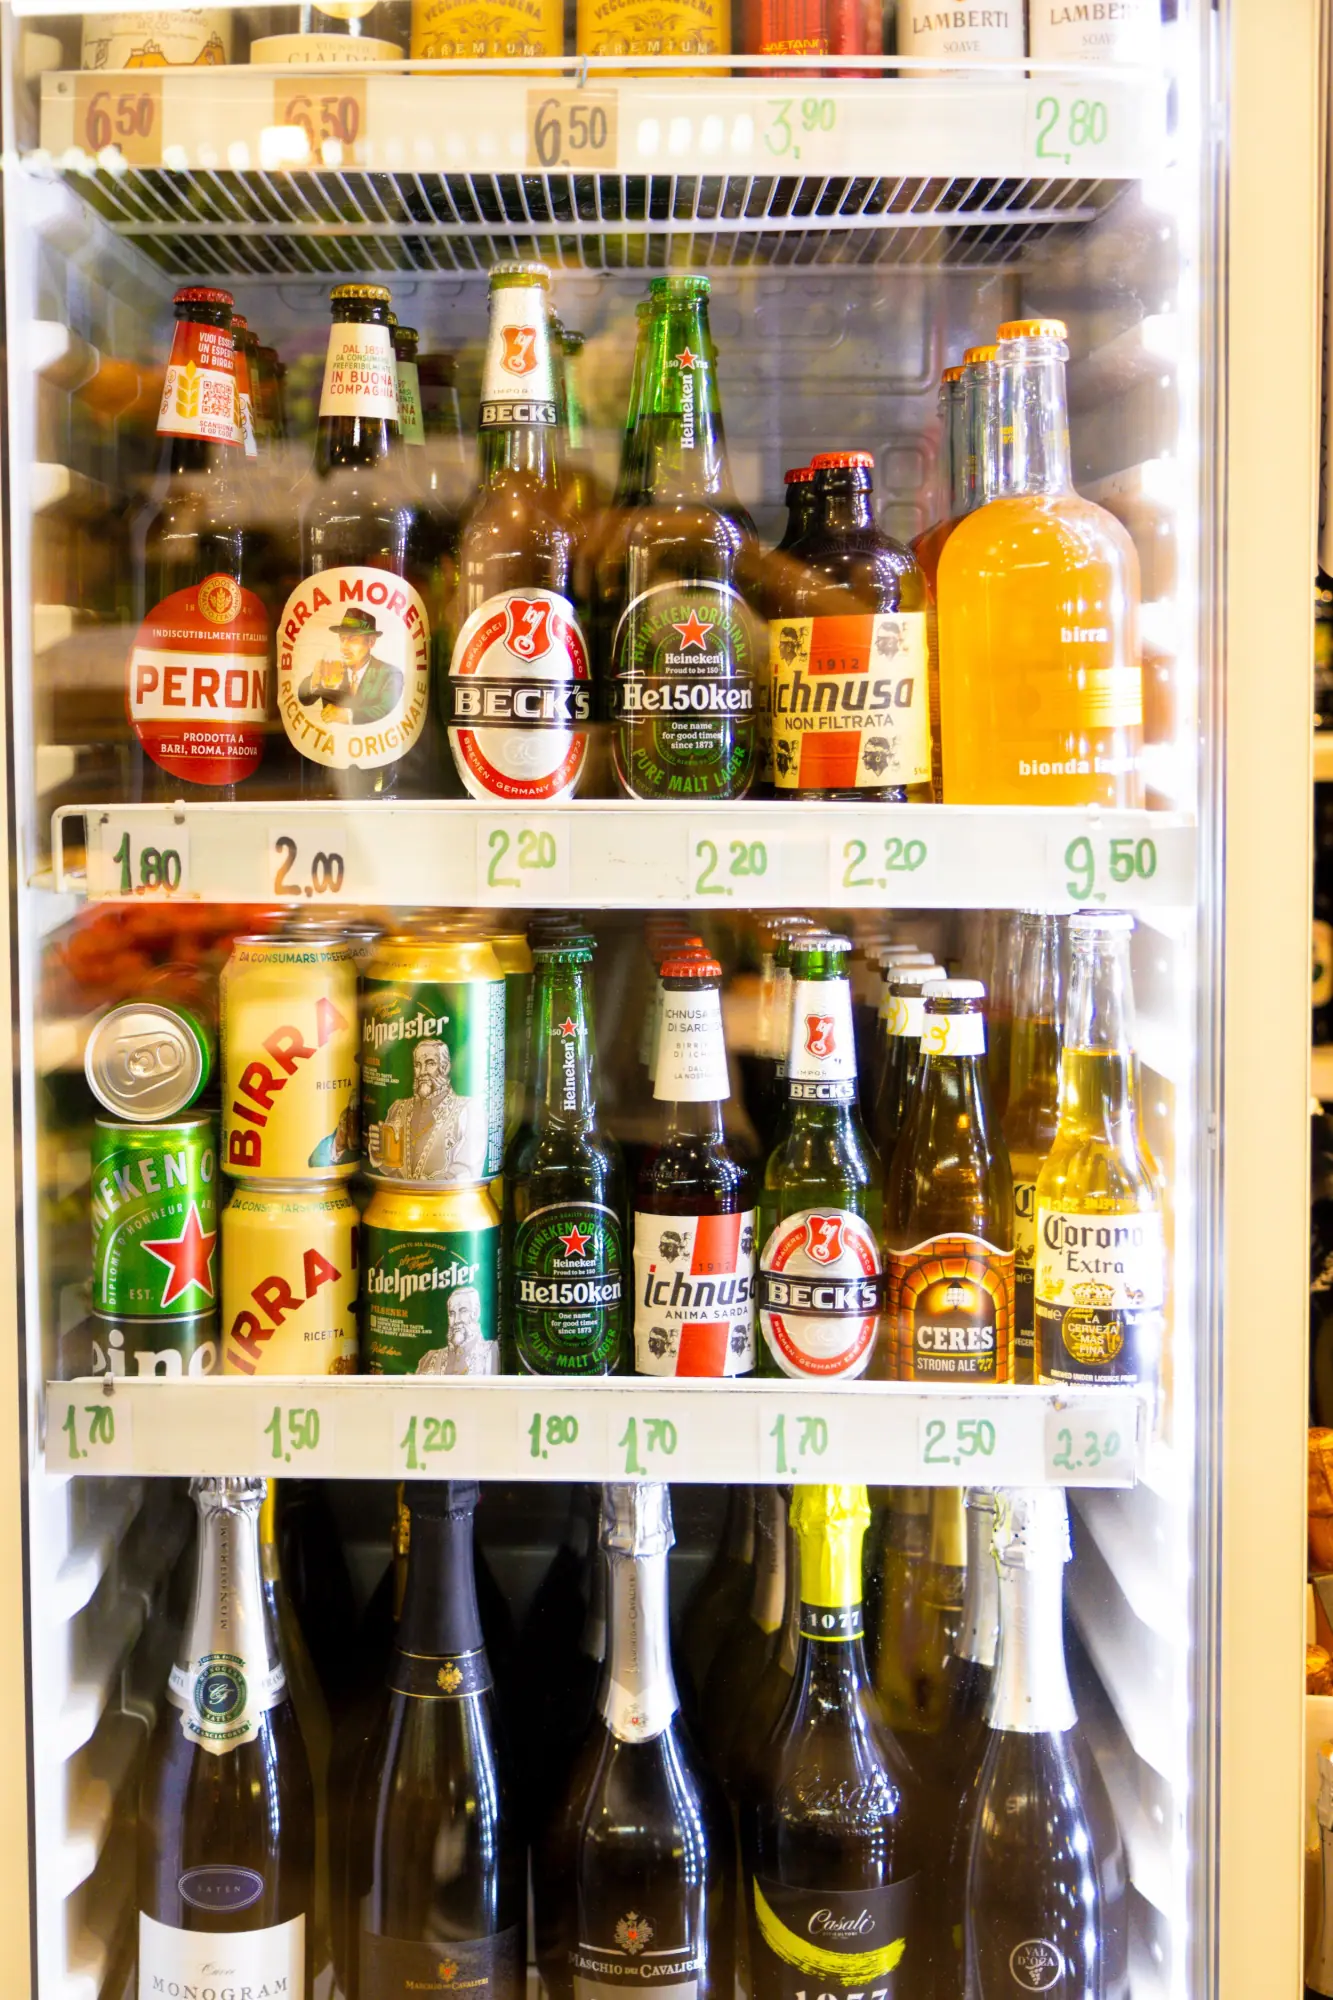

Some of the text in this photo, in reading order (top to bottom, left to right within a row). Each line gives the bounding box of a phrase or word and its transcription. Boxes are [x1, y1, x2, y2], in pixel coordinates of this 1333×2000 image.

[912, 11, 1009, 34] LAMBERTI
[427, 41, 536, 57] PREMIUM
[599, 41, 710, 57] PREMIUM
[943, 40, 981, 53] SOAVE
[199, 332, 216, 344] VUOI
[198, 343, 209, 353] UN
[342, 344, 360, 354] DAL
[200, 354, 209, 364] DI
[335, 353, 344, 362] DA
[331, 370, 393, 388] IN BUONA
[482, 402, 557, 424] BECK'S
[680, 373, 695, 449] Heineken
[280, 579, 428, 671] BIRRA MORETTI
[152, 628, 240, 641] INDISCUTIBILMENTE
[630, 605, 748, 663] HEINEKEN ORIGINAL
[1060, 627, 1109, 643] birra
[465, 622, 504, 670] BRAUEREI
[664, 652, 720, 665] Heineken
[816, 658, 860, 670] 1912
[664, 666, 688, 675] Proud
[688, 666, 696, 674] to
[696, 666, 707, 674] be
[454, 684, 590, 721] BECK'S
[622, 683, 753, 711] He150ken
[280, 679, 428, 759] RICETTA ORIGINALE
[671, 721, 713, 730] One name
[784, 713, 894, 730] NON FILTRATA
[183, 732, 245, 744] PRODOTTA A
[661, 731, 722, 742] for good times
[160, 743, 259, 757] BARI, ROMA, PADOVA
[670, 739, 714, 750] since 1873
[462, 736, 491, 782] BREMEN
[495, 779, 551, 796] GERMANY
[631, 747, 665, 785] PURE
[668, 774, 709, 794] MALT
[713, 745, 746, 788] LAGER
[1018, 757, 1091, 777] bionda
[239, 951, 319, 964] DA CONSUMARSI
[668, 1022, 677, 1032] DI
[228, 997, 350, 1168] BIRRA
[315, 1077, 353, 1091] RICETTA
[562, 1041, 577, 1112] Heineken
[231, 1199, 241, 1209] DA
[119, 1204, 184, 1246] D'HONNEUR
[526, 1221, 617, 1265] HEINEKEN ORIGINAL
[775, 1232, 804, 1268] BRAUEREI
[552, 1258, 597, 1268] Heineken
[1066, 1250, 1125, 1274] Extra
[108, 1249, 122, 1305] DIPLOME
[552, 1268, 571, 1276] Proud
[571, 1268, 578, 1276] to
[577, 1268, 586, 1276] be
[367, 1260, 481, 1303] Edelmeister
[129, 1288, 155, 1301] EST.
[520, 1279, 622, 1305] He150ken
[768, 1280, 877, 1311] BECK'S
[558, 1311, 591, 1320] One name
[664, 1307, 749, 1320] ANIMA SARDA
[1084, 1314, 1100, 1324] LA
[551, 1319, 598, 1329] for good times
[557, 1327, 592, 1335] since 1873
[1067, 1324, 1118, 1335] CERVEZA
[303, 1328, 345, 1342] RICETTA
[916, 1325, 994, 1351] CERES
[1080, 1335, 1105, 1345] MAS
[529, 1327, 617, 1368] PURE MALT LAGER
[773, 1320, 842, 1372] BREMEN GERMANY
[916, 1357, 956, 1372] STRONG
[957, 1359, 977, 1372] ALE
[1050, 1368, 1073, 1380] BREWED
[1073, 1371, 1094, 1382] UNDER
[1094, 1374, 1120, 1382] LICENCE
[807, 1908, 876, 1935] Casali
[1024, 1946, 1048, 1957] VAL
[568, 1952, 623, 1975] MASCHIO
[152, 1975, 289, 2000] MONOGRAM
